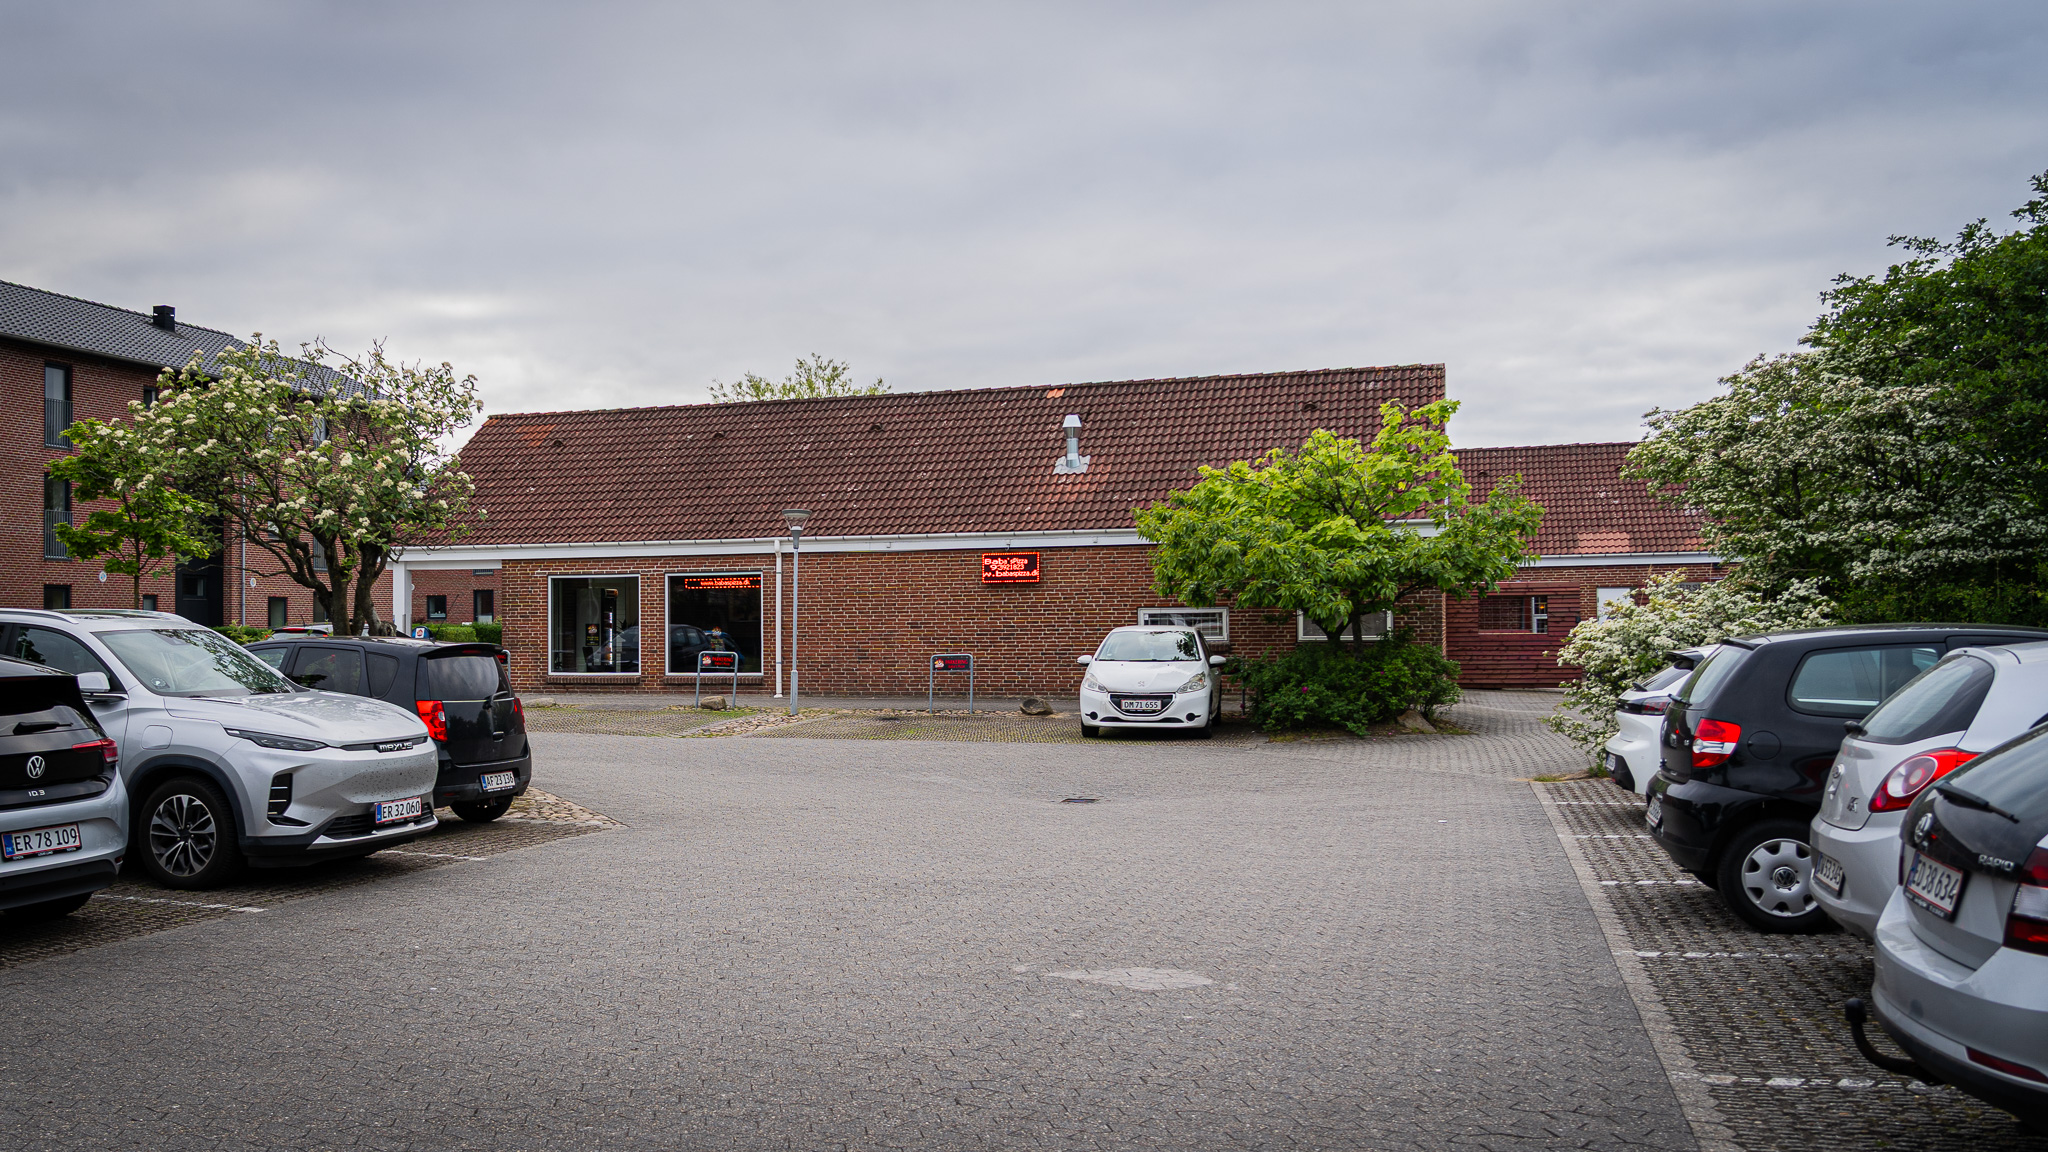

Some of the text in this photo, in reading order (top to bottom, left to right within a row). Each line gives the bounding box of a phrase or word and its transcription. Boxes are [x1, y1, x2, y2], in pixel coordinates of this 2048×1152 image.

[1124, 701, 1158, 709] DM 71 655
[486, 772, 514, 787] AF 23 136
[382, 800, 420, 819] ER 32 060
[14, 827, 78, 852] ER 78 109
[1978, 854, 2015, 871] RAPID
[1921, 864, 1938, 894] 38
[1934, 871, 1960, 906] 634
